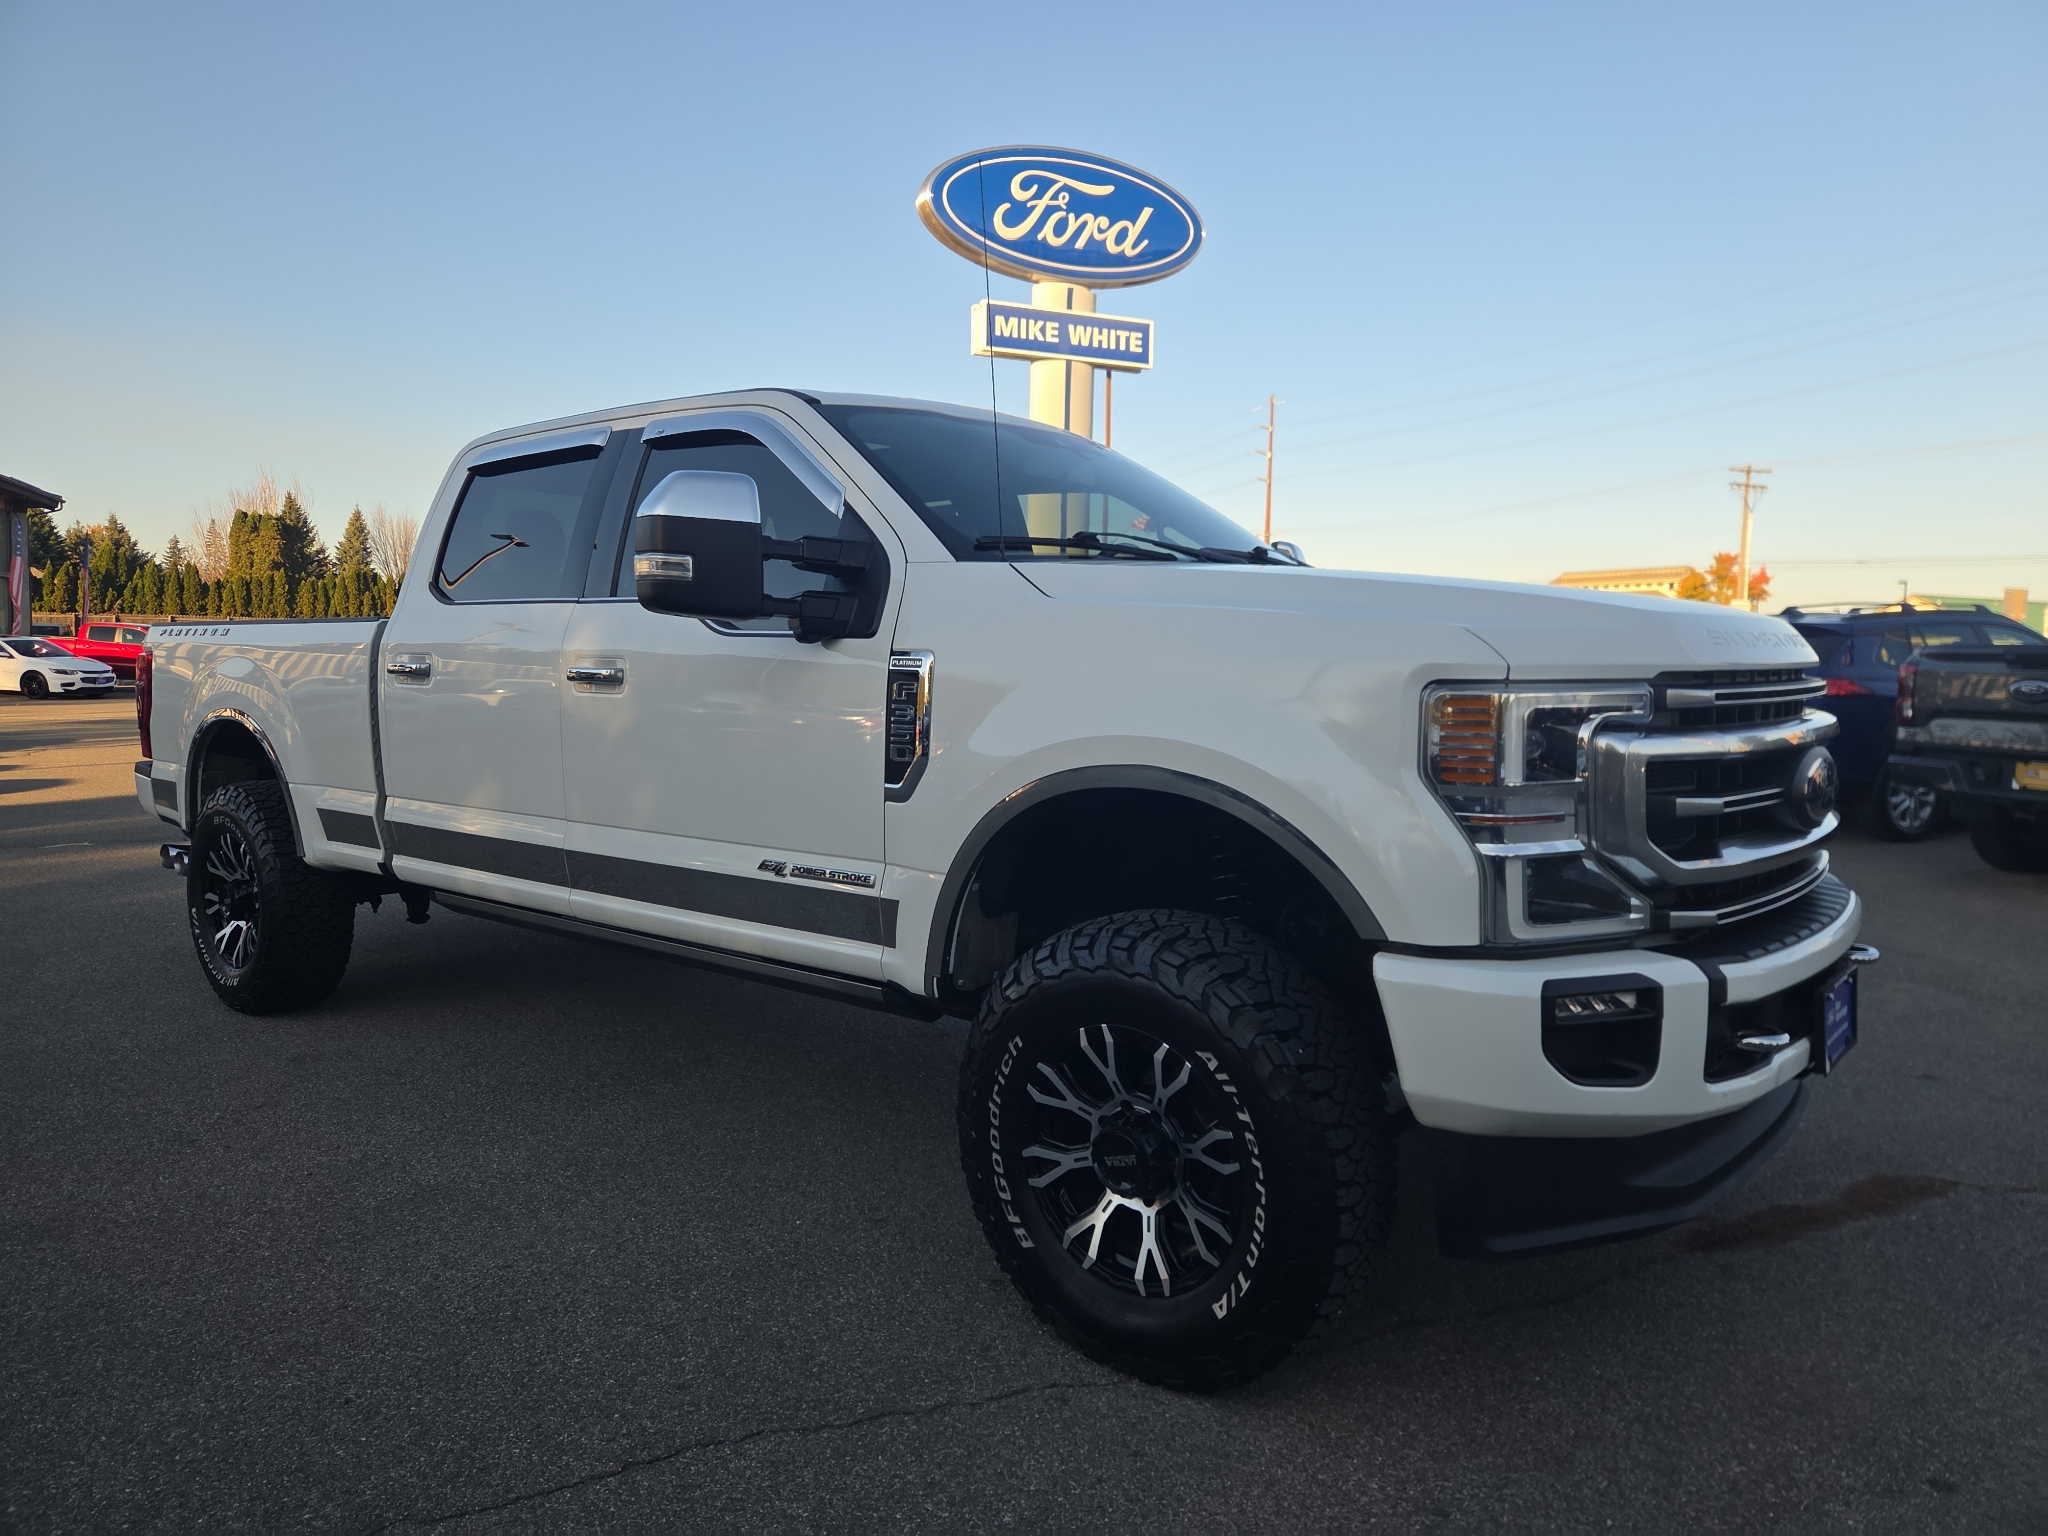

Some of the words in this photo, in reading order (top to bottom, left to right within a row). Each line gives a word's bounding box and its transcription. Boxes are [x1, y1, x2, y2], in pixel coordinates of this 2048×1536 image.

[993, 169, 1154, 258] Ford
[994, 315, 1060, 344] MIKE
[1067, 324, 1144, 353] WHITE
[159, 627, 231, 637] PLATINUM
[892, 659, 922, 667] PLATINUM
[791, 865, 827, 878] POWER
[828, 870, 872, 884] STROKE
[988, 1034, 1036, 1249] BFGoodrich
[1195, 1049, 1267, 1268] All-Terrain
[1211, 1270, 1252, 1320] T/A
